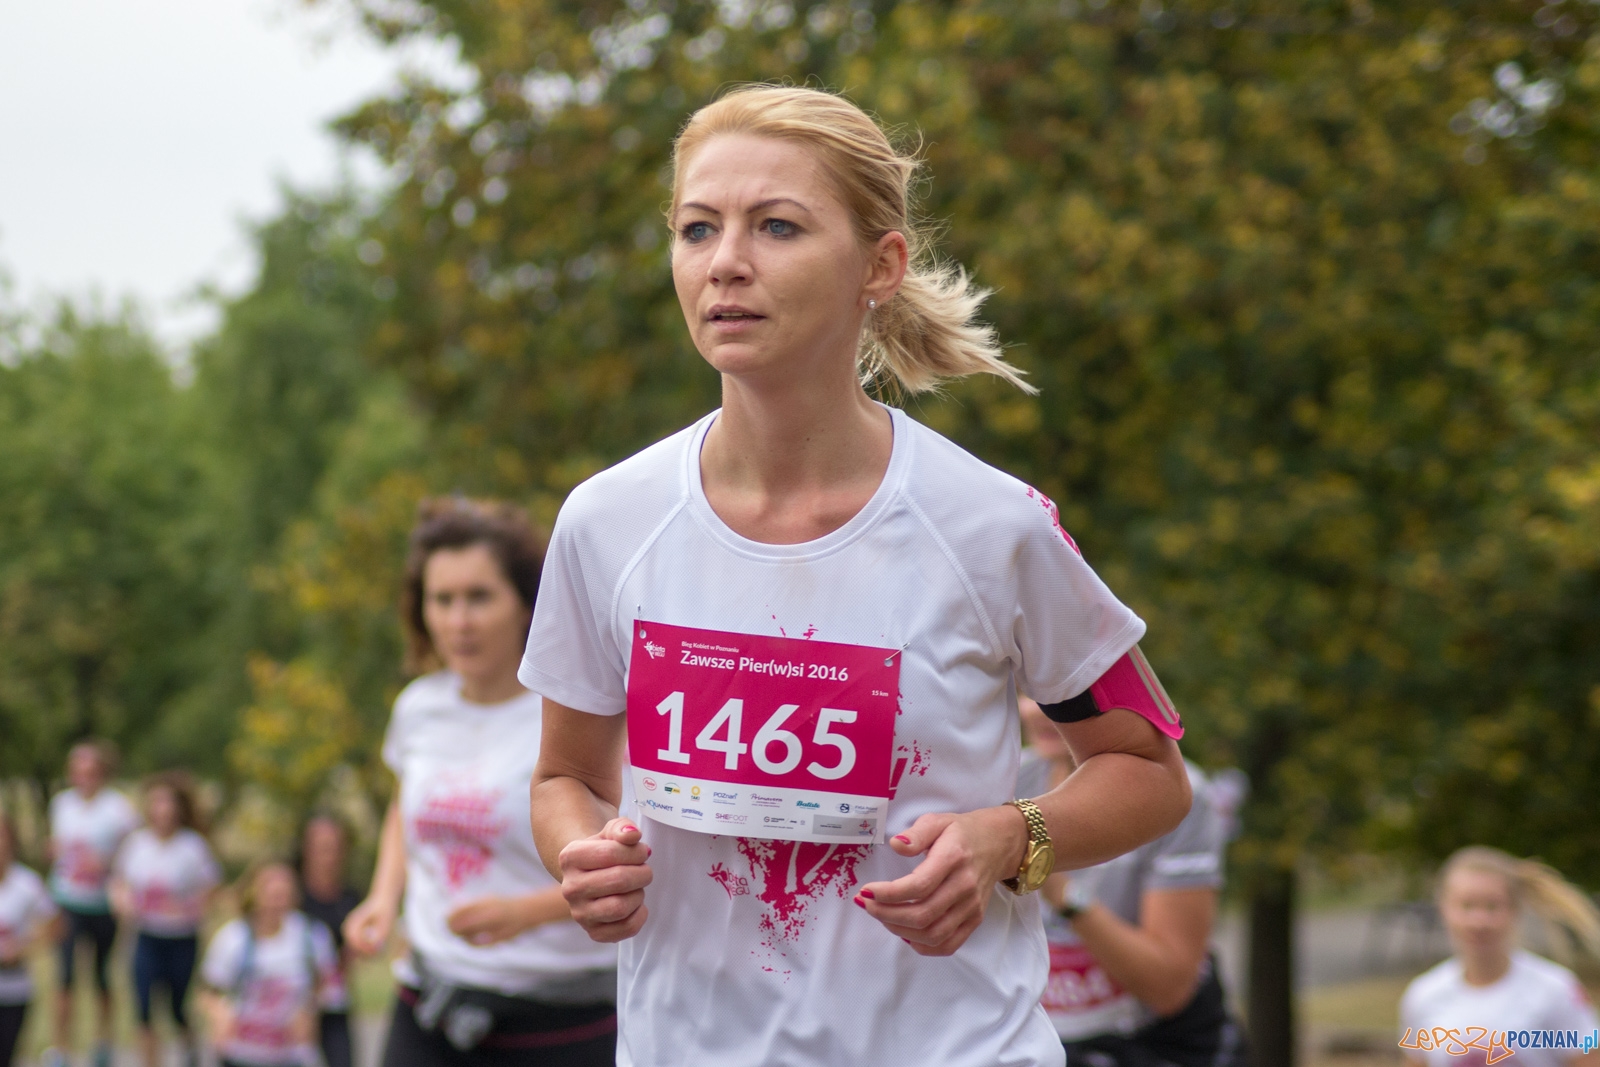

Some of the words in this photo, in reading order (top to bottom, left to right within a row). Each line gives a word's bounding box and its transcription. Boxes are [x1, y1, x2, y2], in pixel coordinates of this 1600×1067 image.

[693, 642, 709, 650] Kobiet
[716, 645, 739, 653] Poznaniu
[680, 650, 735, 670] Zawsze
[739, 657, 804, 679] Pier(w)si
[808, 664, 849, 682] 2016
[655, 691, 858, 780] 1465
[715, 812, 748, 823] SHEFOOT
